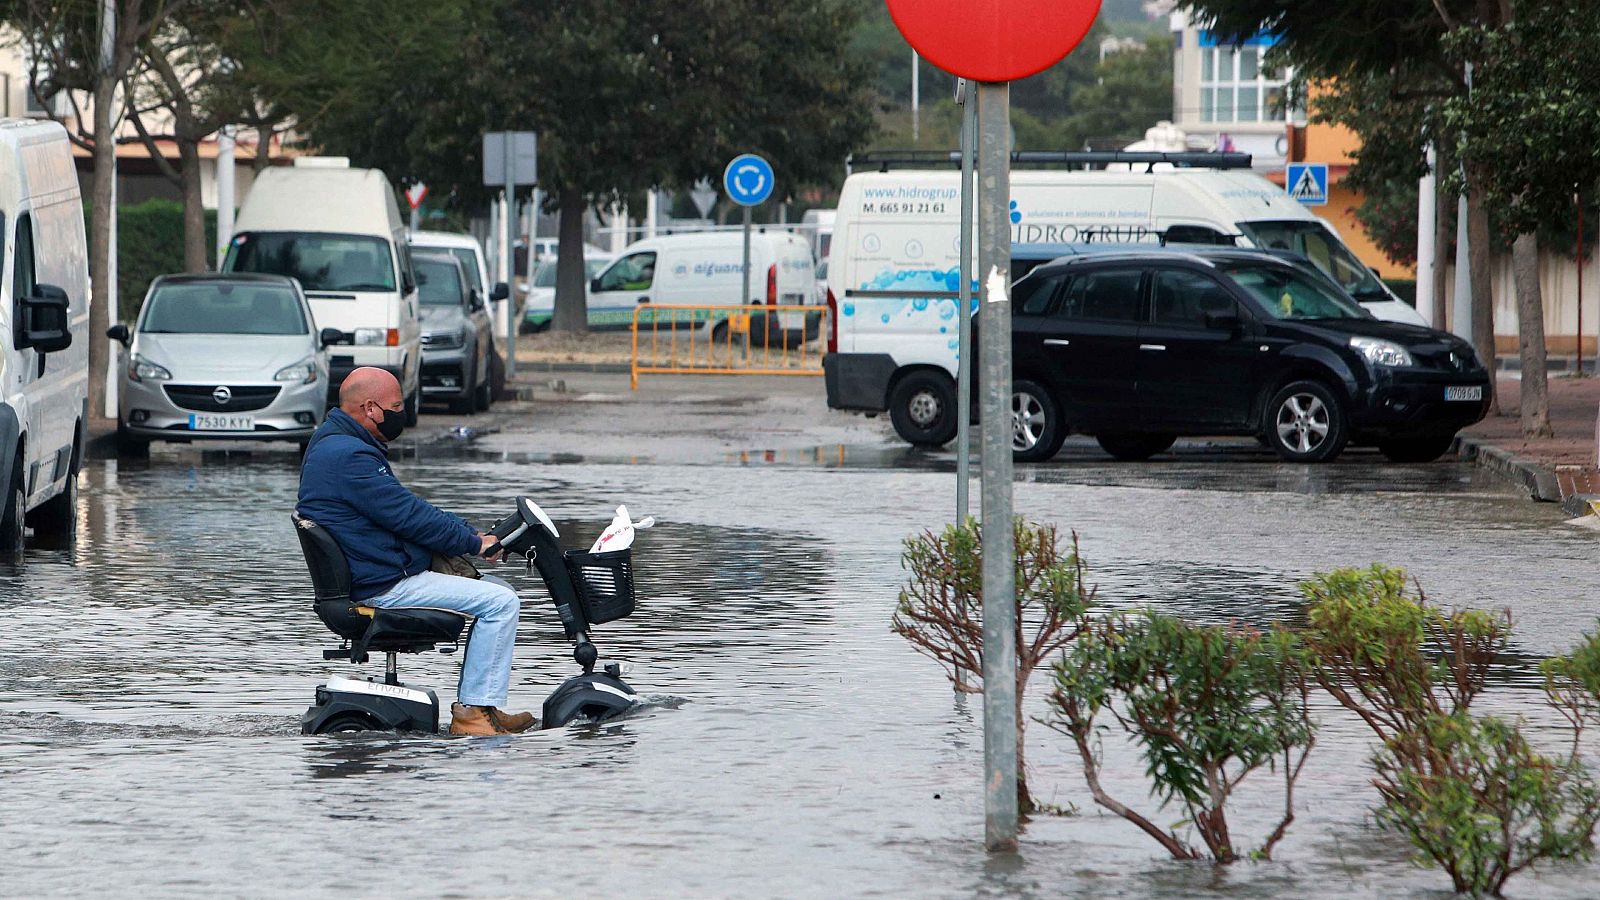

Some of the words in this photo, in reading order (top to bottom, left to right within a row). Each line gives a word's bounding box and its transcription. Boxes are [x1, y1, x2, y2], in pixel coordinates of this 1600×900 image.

[863, 203, 877, 213] M.
[880, 203, 899, 213] 665
[902, 203, 914, 213] 91
[917, 203, 929, 213] 21
[933, 203, 945, 213] 61
[1009, 224, 1148, 243] IDROGRUP
[197, 416, 226, 428] 7530
[230, 416, 252, 428] KYY
